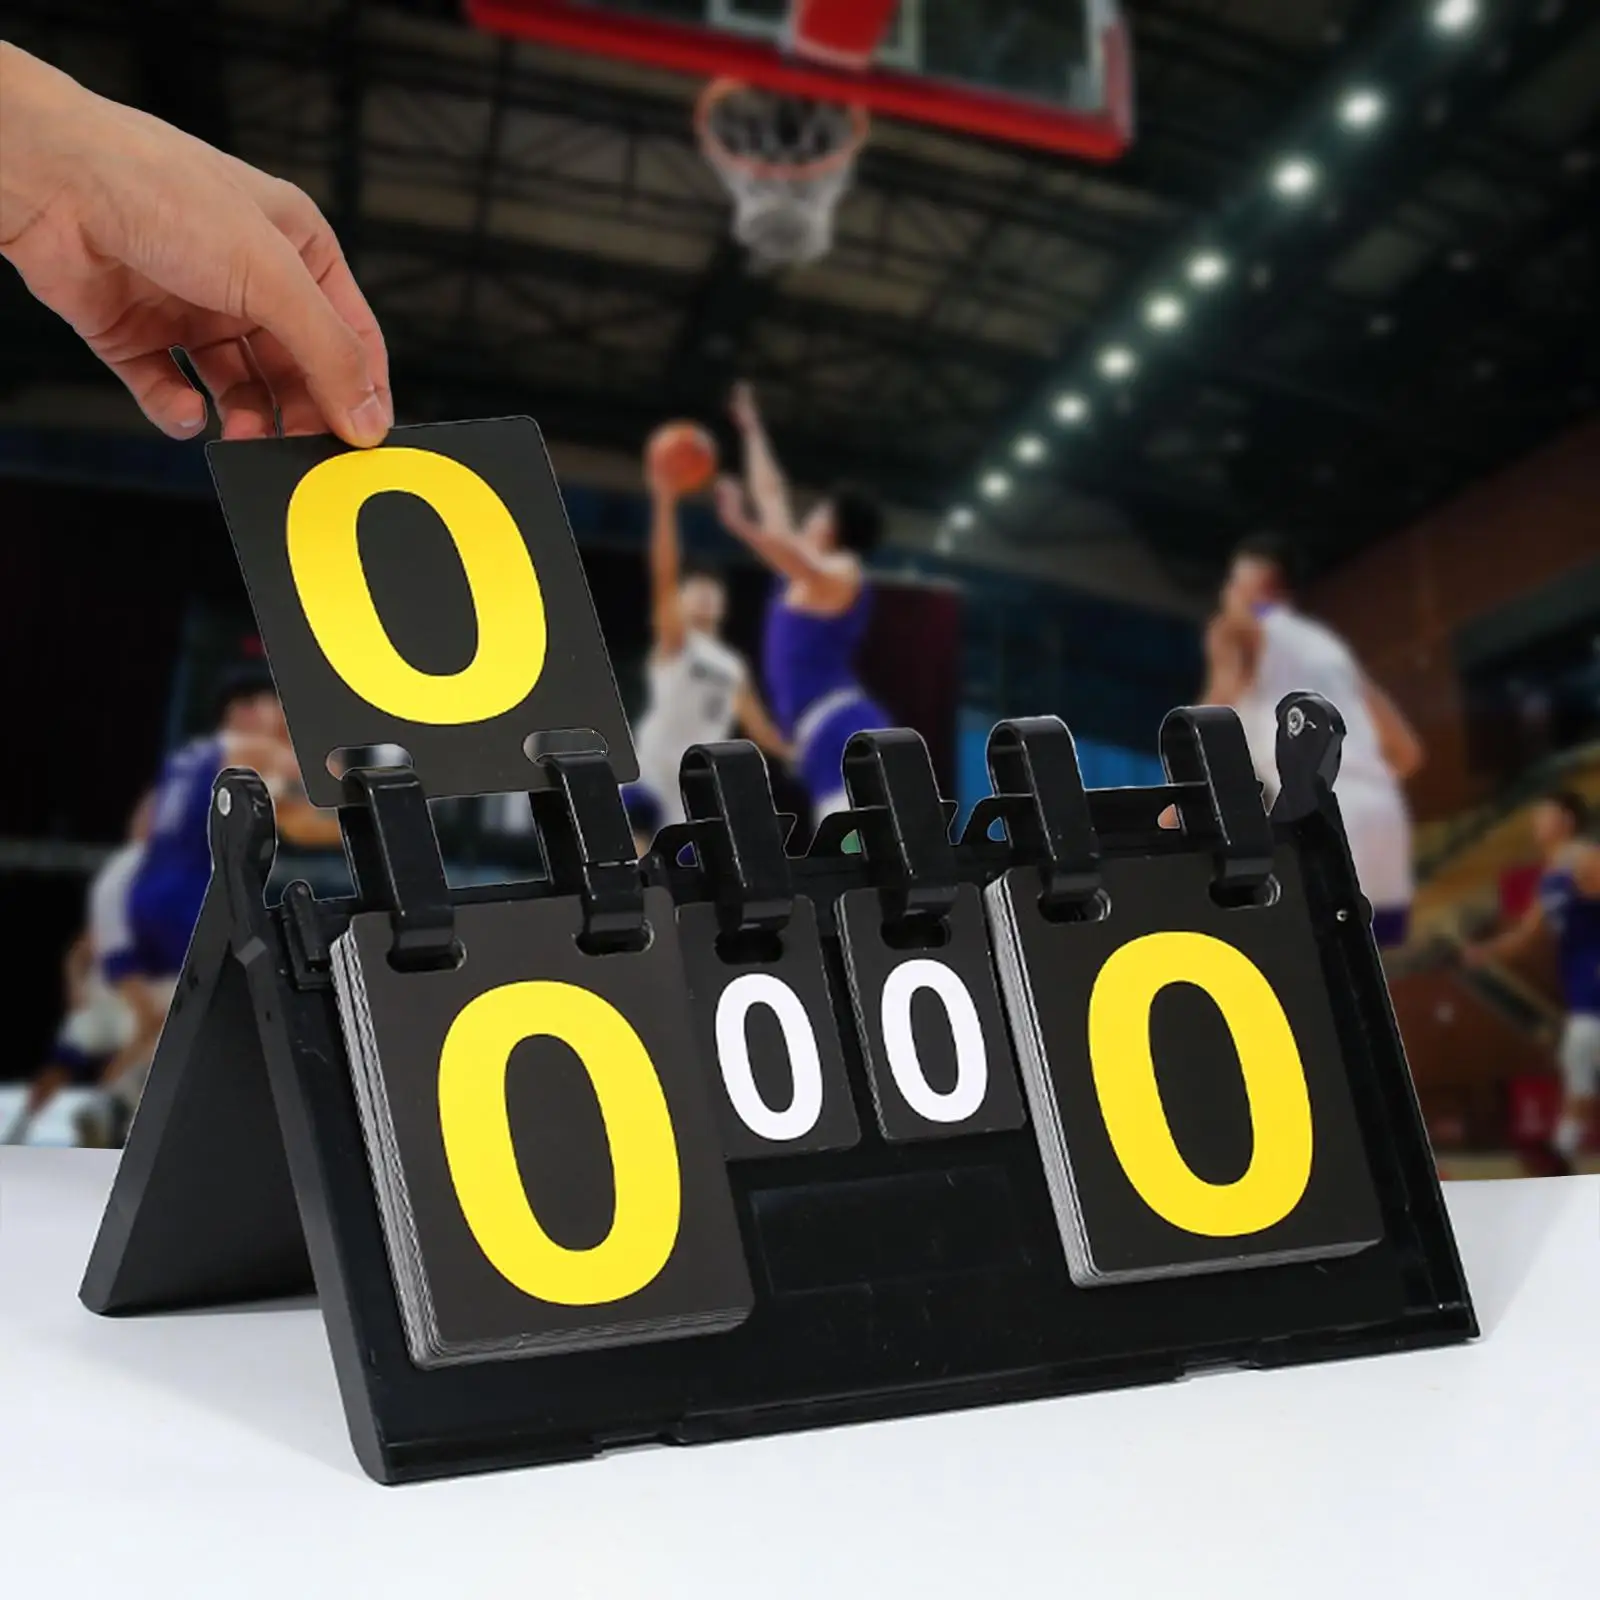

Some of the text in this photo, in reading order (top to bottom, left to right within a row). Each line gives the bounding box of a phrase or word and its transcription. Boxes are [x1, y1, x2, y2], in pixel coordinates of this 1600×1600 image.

[286, 447, 547, 725] 0
[438, 981, 681, 1305] 0
[715, 973, 823, 1140] 0
[881, 959, 987, 1122] 0
[1088, 931, 1313, 1237] 0
